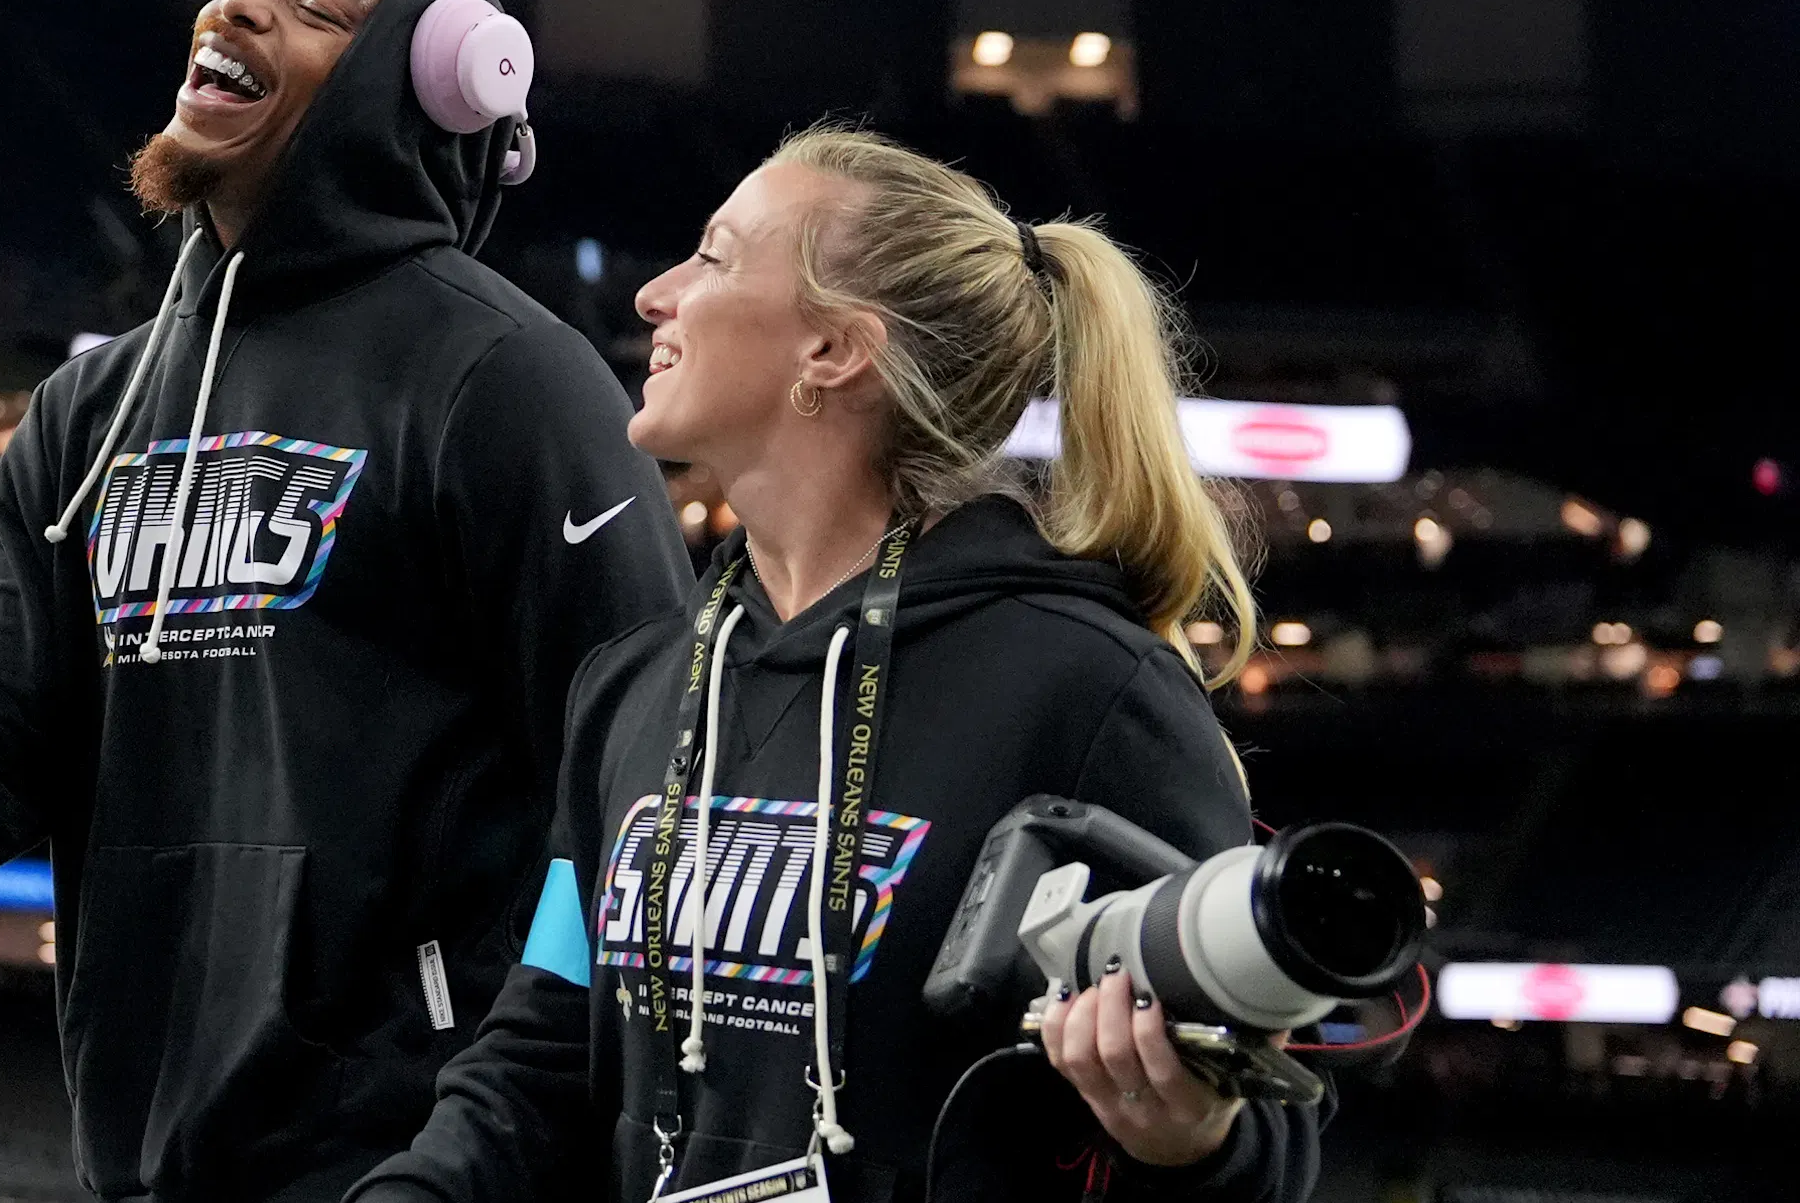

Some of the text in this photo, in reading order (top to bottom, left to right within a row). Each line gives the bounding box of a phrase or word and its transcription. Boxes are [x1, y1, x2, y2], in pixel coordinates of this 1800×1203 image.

[96, 455, 336, 600] VKINGS
[879, 530, 911, 579] SAINTS
[117, 647, 257, 665] MIESOTA FOOBALL
[688, 559, 739, 694] NEW ORLEAN
[828, 664, 881, 913] NEW ORLEANS SAINTS
[647, 783, 682, 1032] NEW ORLEANS SAINTS
[727, 1016, 800, 1035] FOOTBALL
[742, 996, 815, 1018] CANCE
